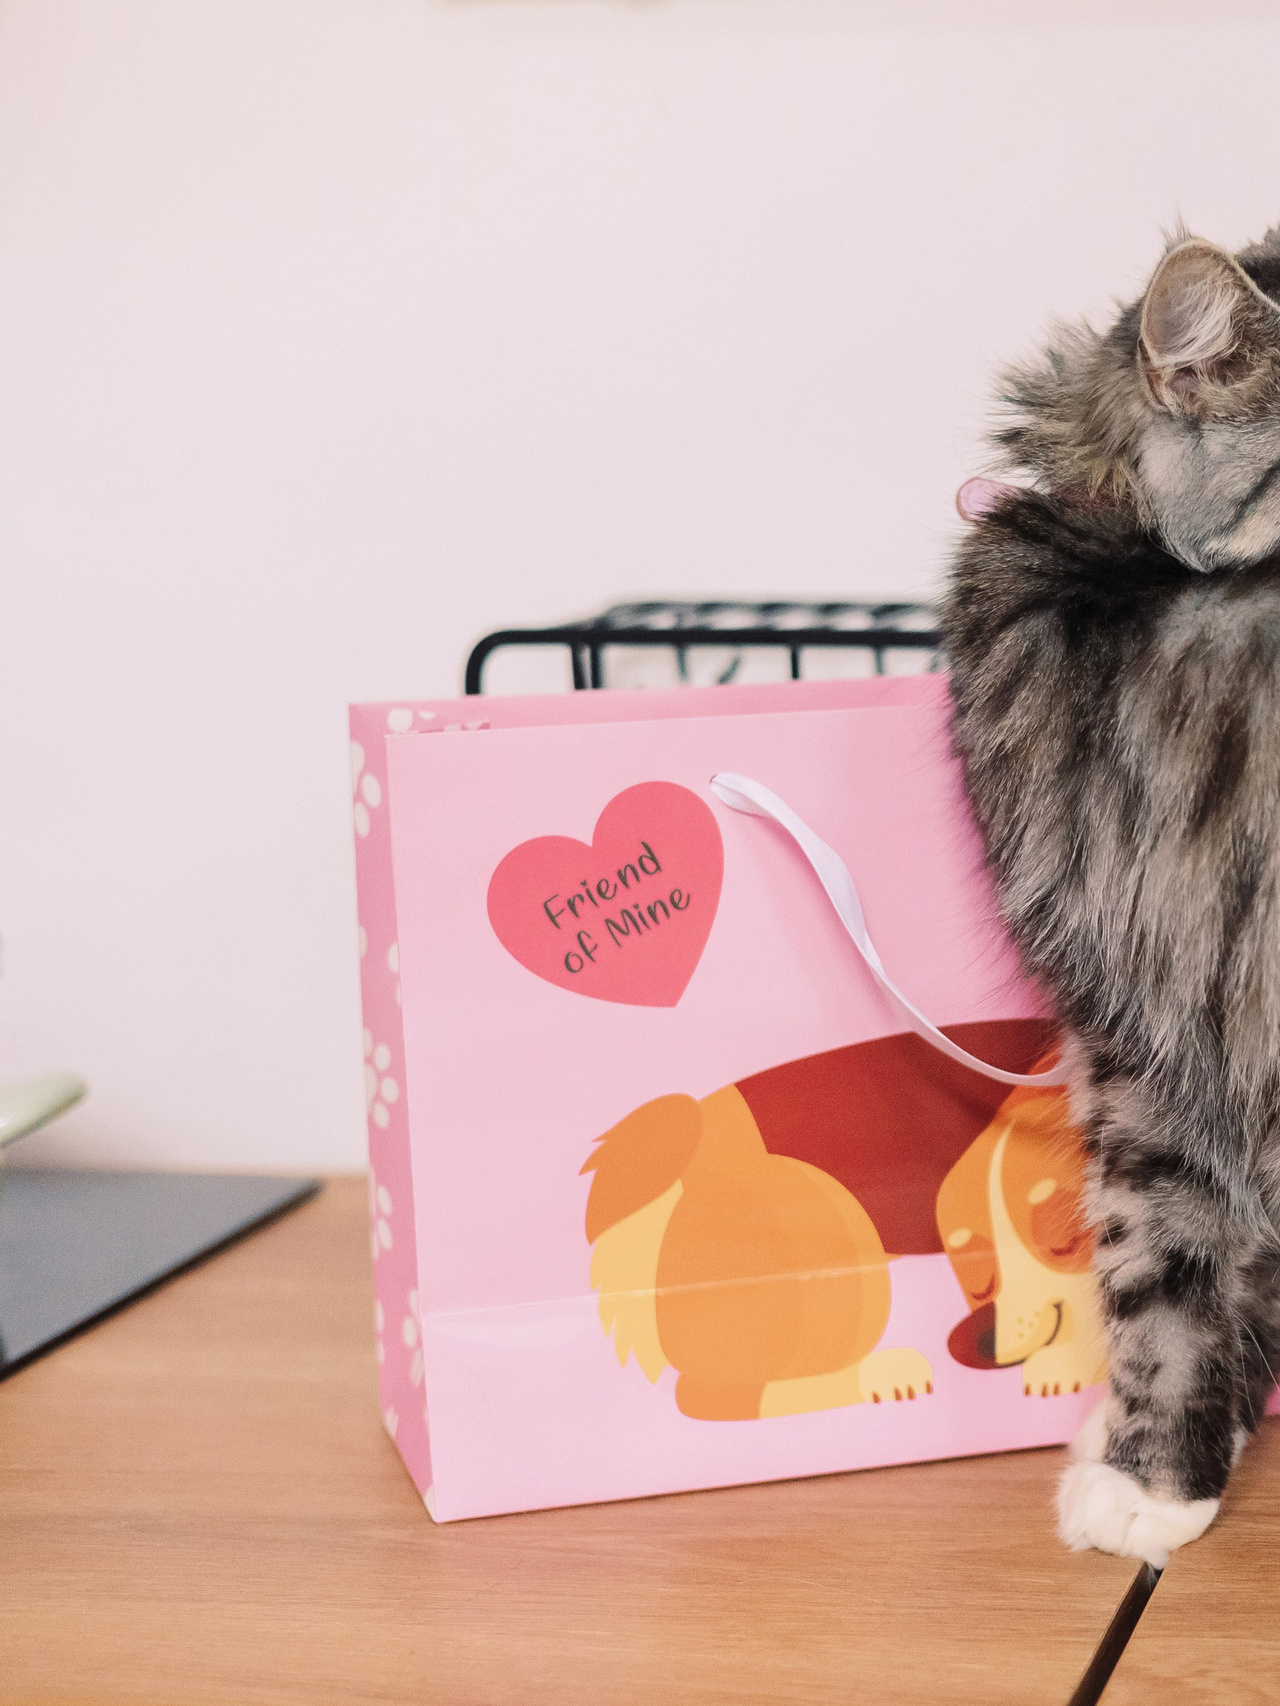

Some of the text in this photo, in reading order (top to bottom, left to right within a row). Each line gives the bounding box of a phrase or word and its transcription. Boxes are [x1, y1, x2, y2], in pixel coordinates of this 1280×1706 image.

[543, 840, 662, 930] Friend
[564, 888, 690, 974] of Mine
